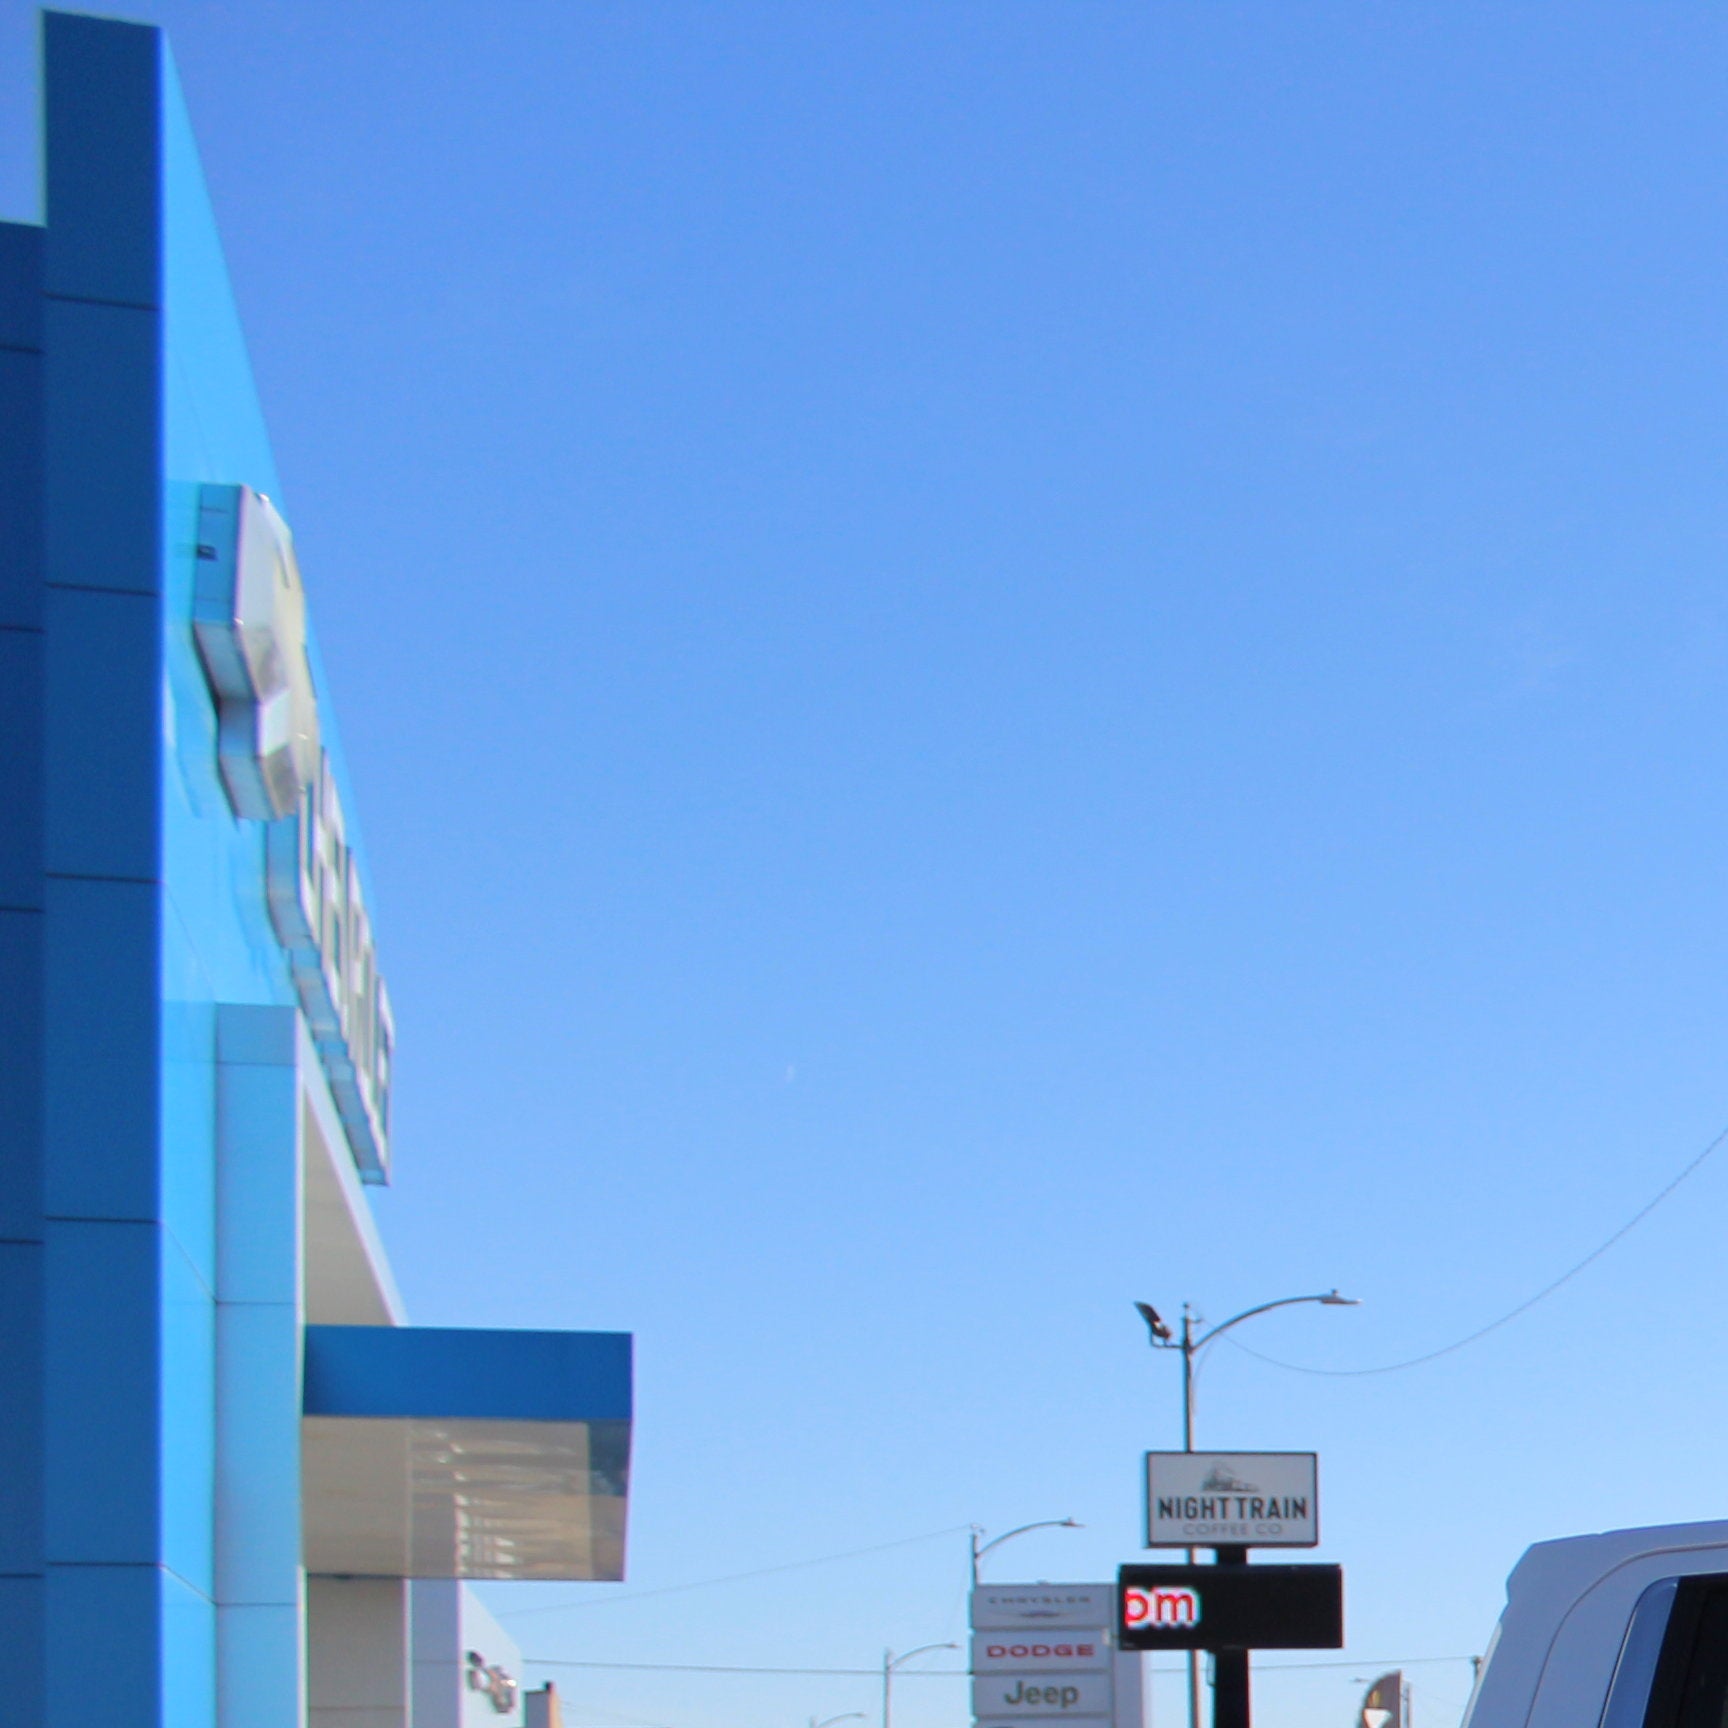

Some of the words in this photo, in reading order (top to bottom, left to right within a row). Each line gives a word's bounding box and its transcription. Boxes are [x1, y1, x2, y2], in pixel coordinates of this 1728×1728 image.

[1158, 1497, 1232, 1519] NIGHT
[1233, 1497, 1306, 1519] TRAIN
[1183, 1522, 1247, 1536] COFFEE
[1255, 1522, 1283, 1536] CO
[986, 1644, 1095, 1658] DODGE
[1004, 1681, 1079, 1708] Jeep
